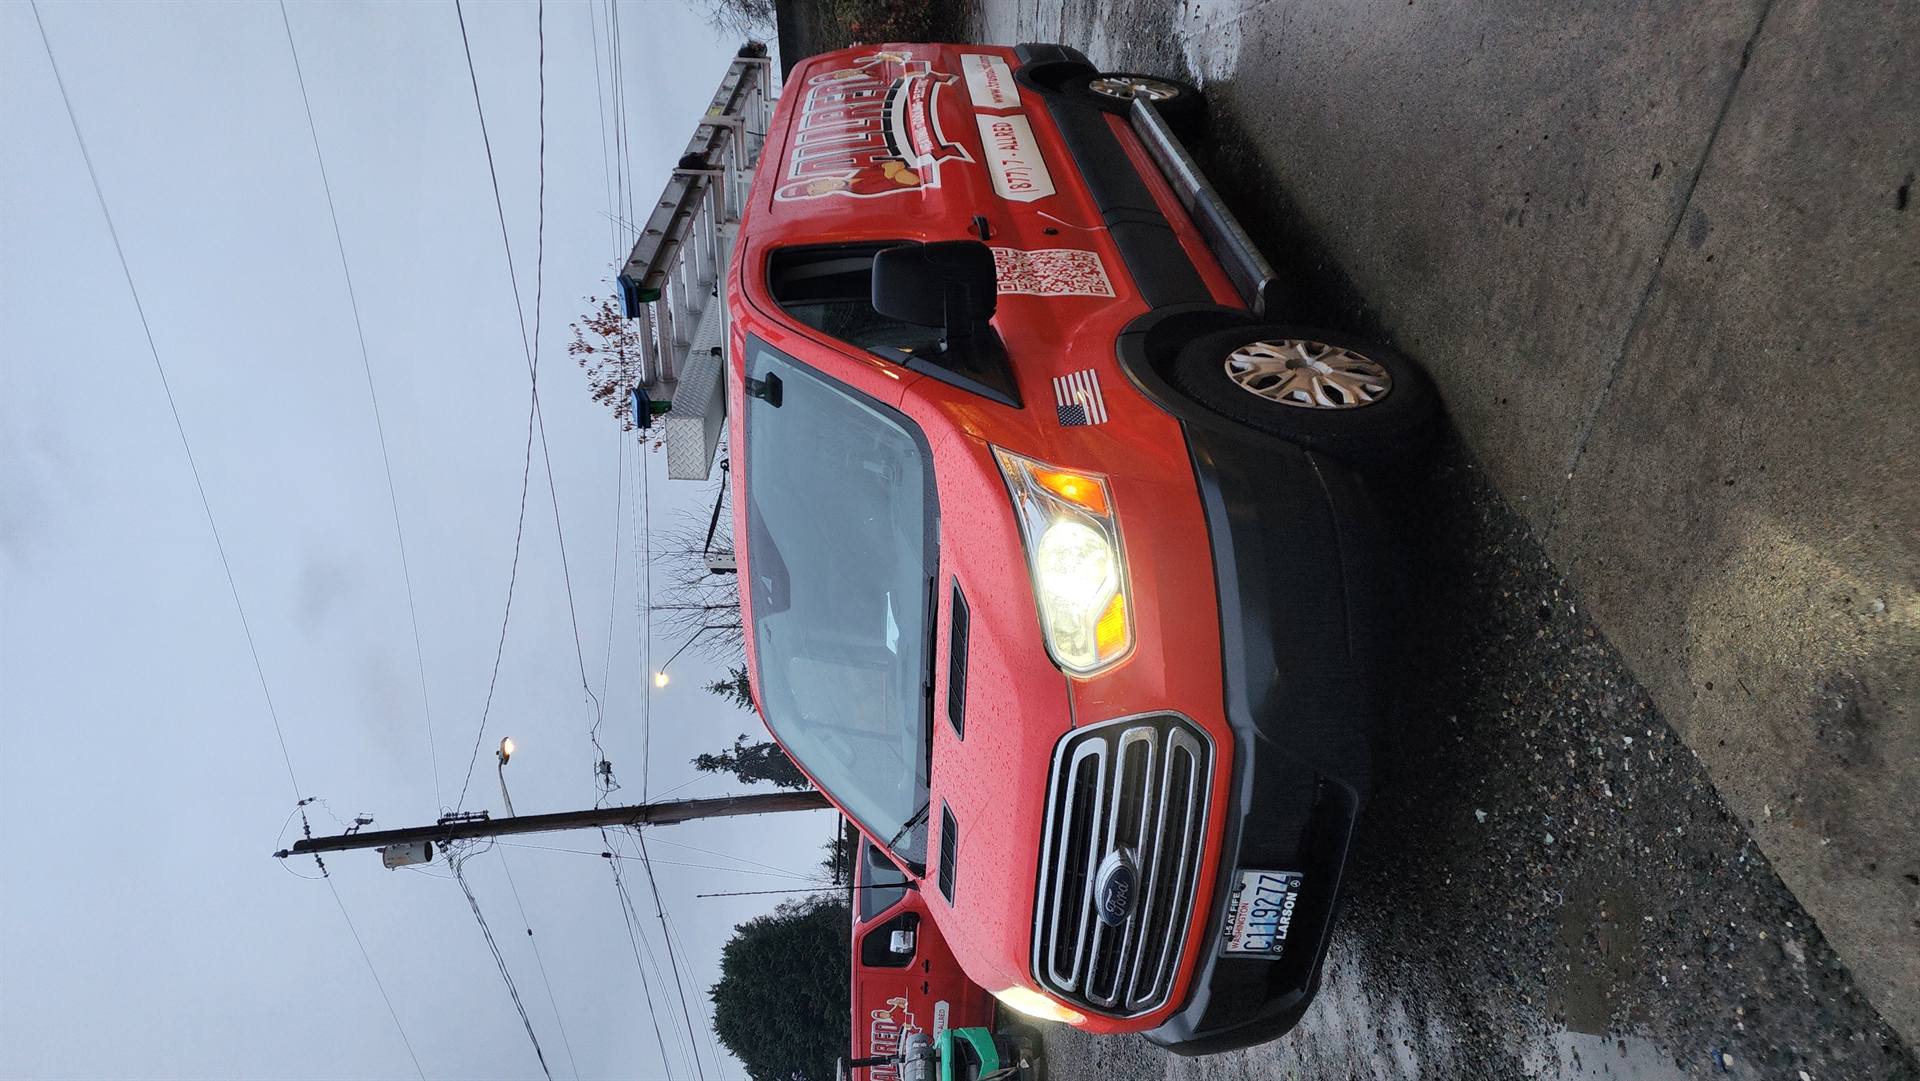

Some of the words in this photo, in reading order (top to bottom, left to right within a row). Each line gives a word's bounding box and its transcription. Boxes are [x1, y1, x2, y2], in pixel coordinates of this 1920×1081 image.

[787, 78, 899, 180] ALLRED
[992, 122, 1020, 151] ALLRED
[1003, 167, 1040, 194] (877)
[1105, 880, 1129, 917] Ford
[1230, 892, 1240, 912] FIFE
[1276, 892, 1298, 940] LARSON
[1227, 914, 1236, 925] AT
[1231, 902, 1249, 949] WASHINGTON
[870, 1021, 902, 1081] ALRED
